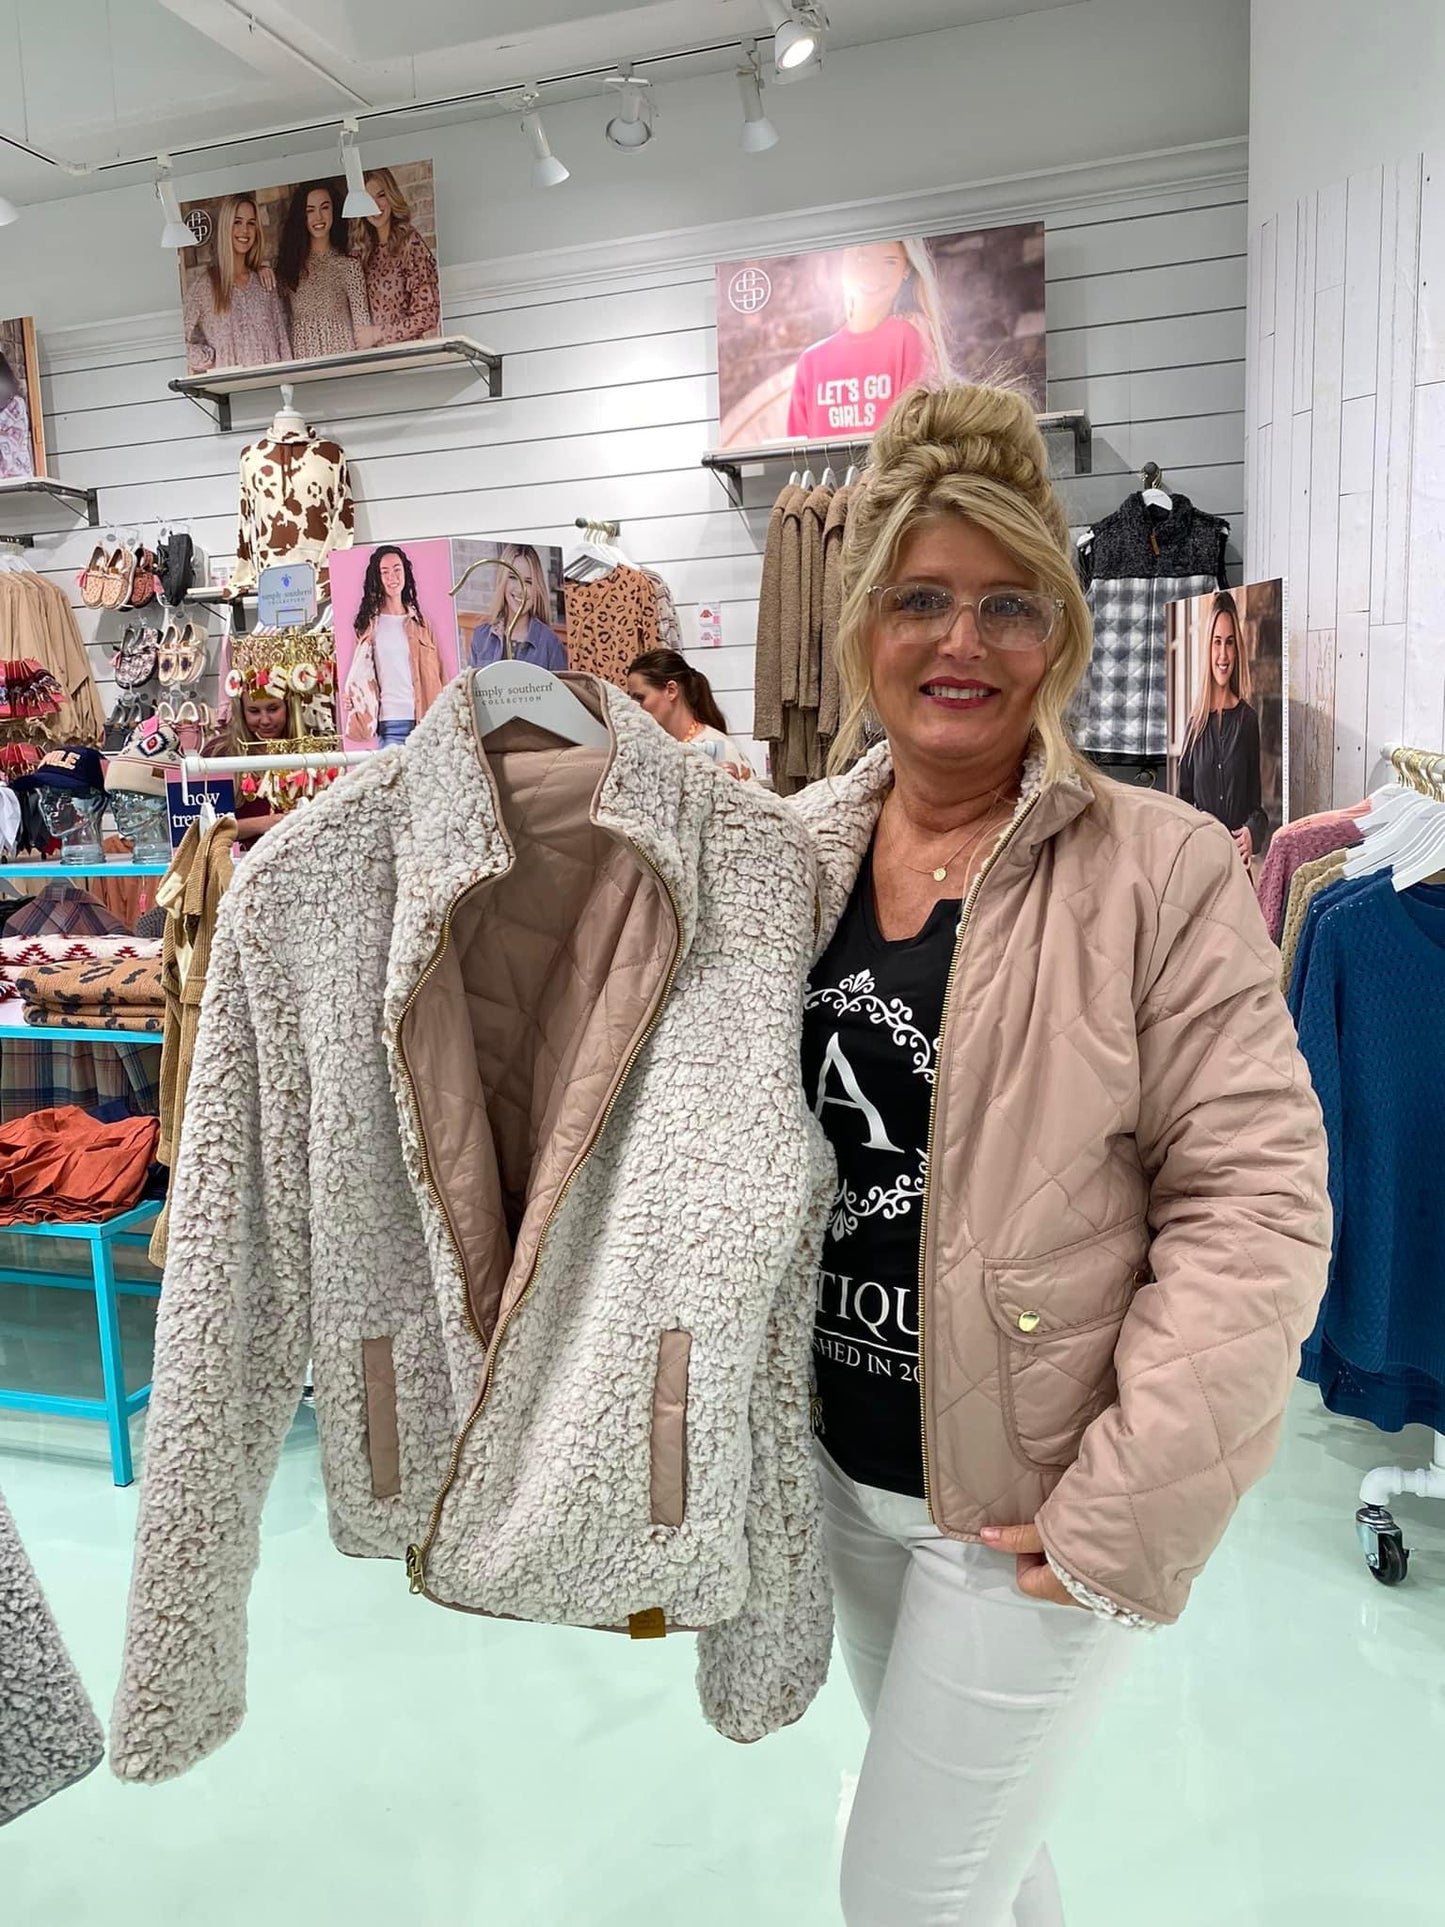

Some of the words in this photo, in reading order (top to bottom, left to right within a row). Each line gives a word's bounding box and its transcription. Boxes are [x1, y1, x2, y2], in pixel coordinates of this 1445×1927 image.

[817, 377, 860, 406] LET'S
[864, 373, 892, 400] GO
[828, 402, 877, 428] GIRLS
[474, 685, 504, 699] imply
[508, 682, 553, 695] southern
[481, 695, 542, 706] COLLECTION
[814, 1031, 905, 1154] A
[815, 1269, 921, 1342] TIQU
[867, 1352, 892, 1377] IN
